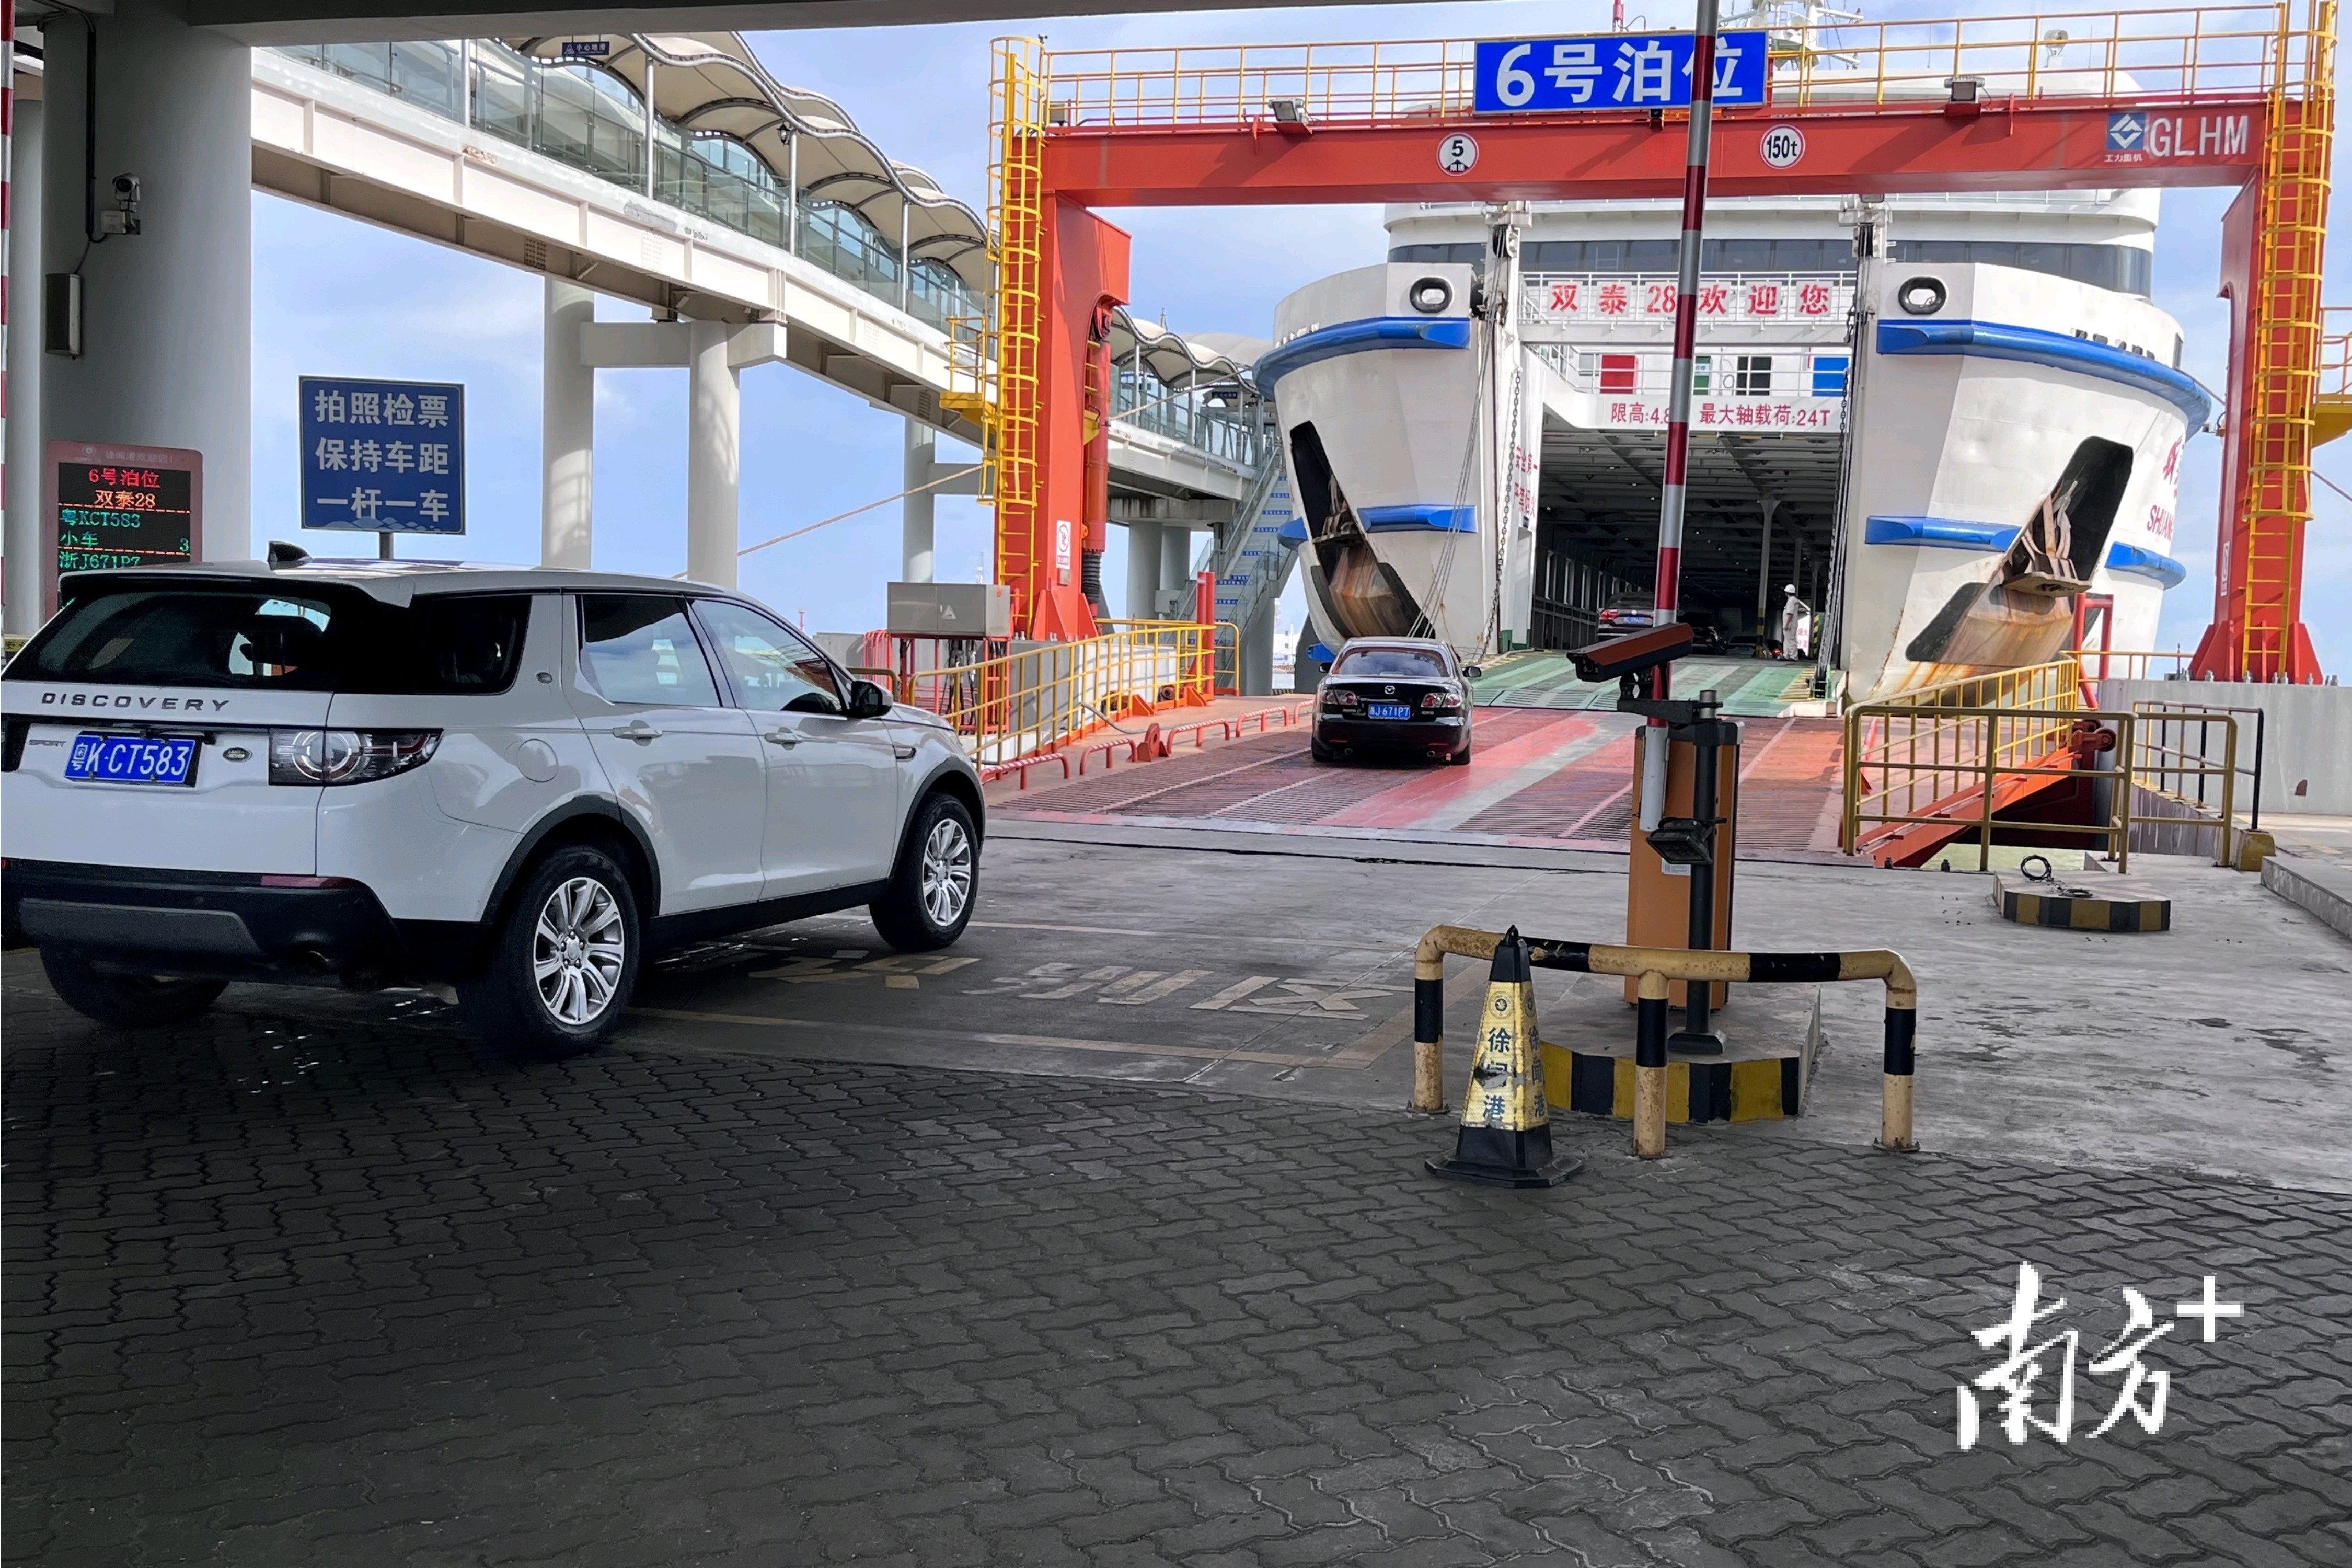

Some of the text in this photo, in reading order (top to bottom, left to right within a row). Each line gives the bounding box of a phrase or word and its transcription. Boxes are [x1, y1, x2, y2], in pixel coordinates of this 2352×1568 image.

[1497, 40, 1742, 106] 6号泊位
[1767, 135, 1797, 159] 150t
[2150, 115, 2248, 157] GLHM
[1452, 140, 1464, 157] 5
[315, 389, 448, 428] 拍照检票
[1700, 403, 1830, 426] 最大轴载荷:24T
[315, 437, 449, 474] 保持车距
[88, 468, 161, 488] 6号泊位
[94, 490, 156, 508] 双泰28
[316, 487, 449, 522] 一杆一车
[60, 509, 141, 528] 粤KCT583
[60, 530, 189, 552] 小车 3
[42, 693, 229, 711] DISCOVERY
